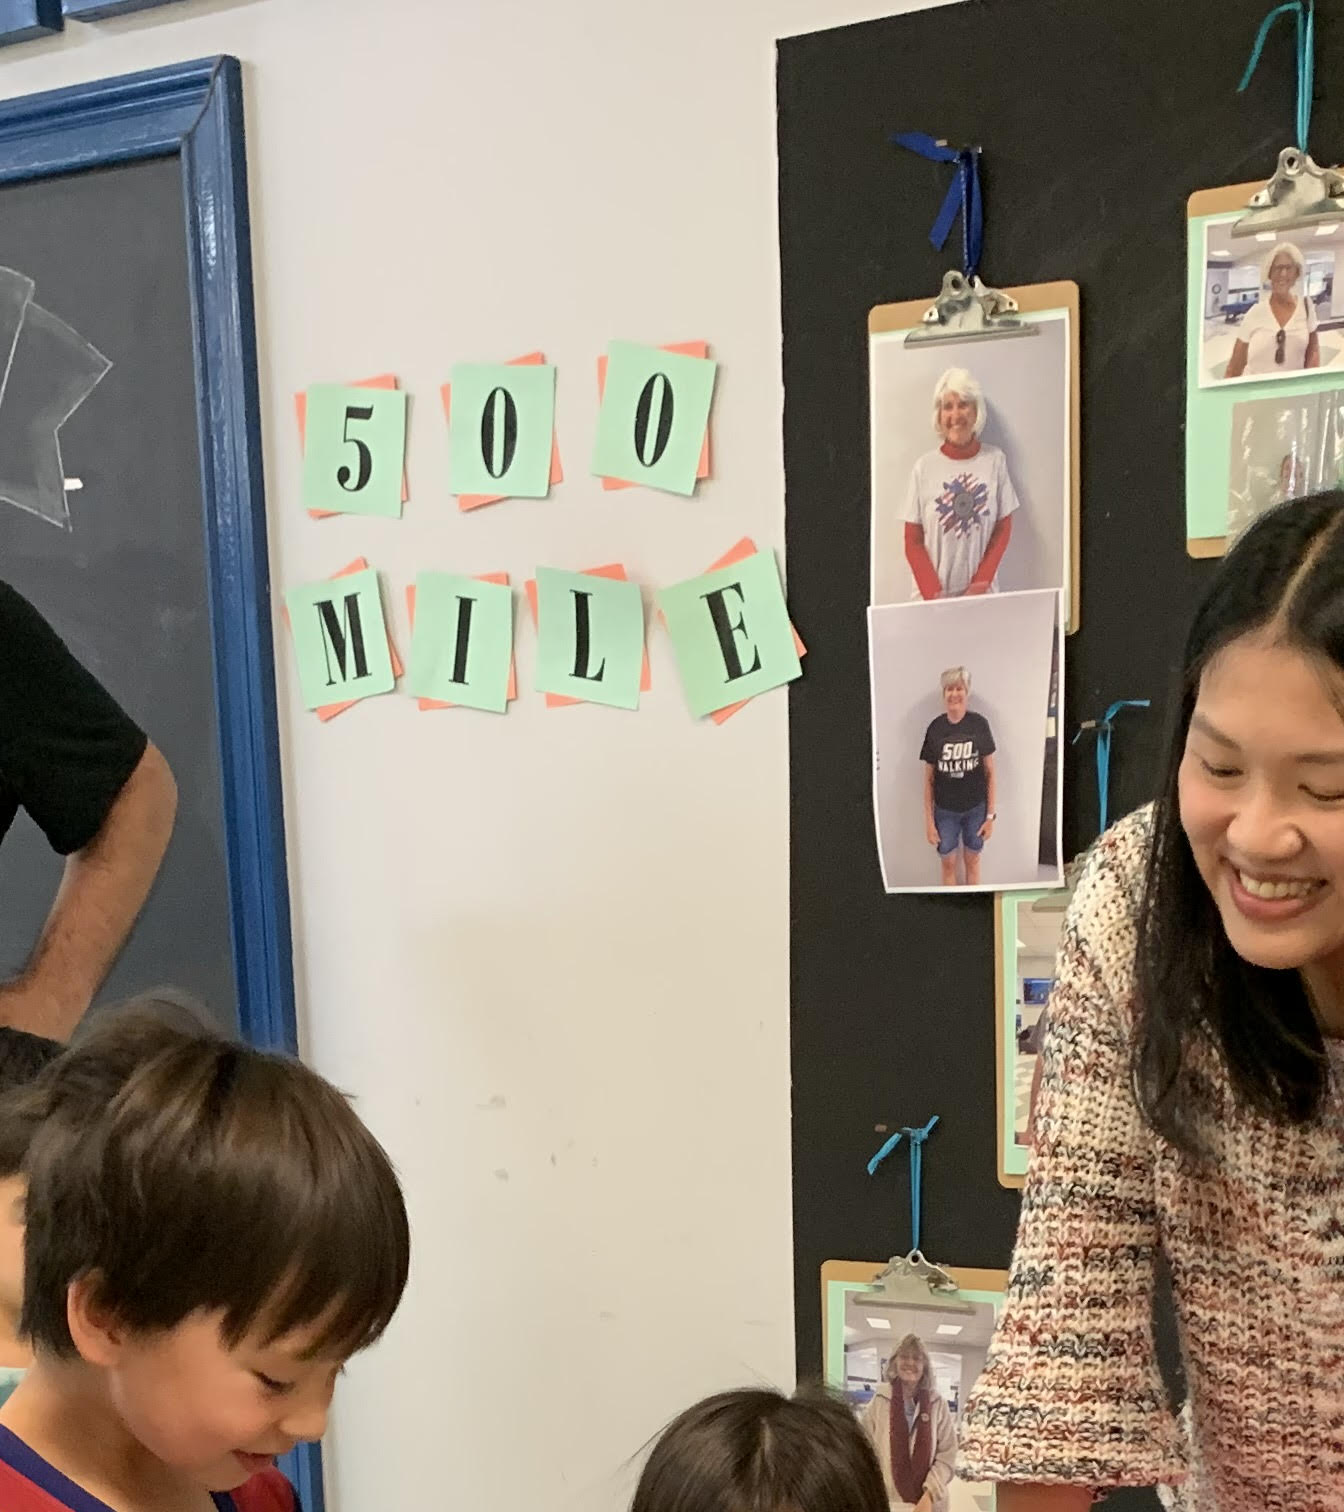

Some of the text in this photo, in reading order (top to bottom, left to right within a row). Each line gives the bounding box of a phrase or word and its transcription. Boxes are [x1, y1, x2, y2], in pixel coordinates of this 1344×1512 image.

[336, 371, 675, 493] 500
[312, 581, 763, 687] MILE
[942, 740, 974, 761] 500
